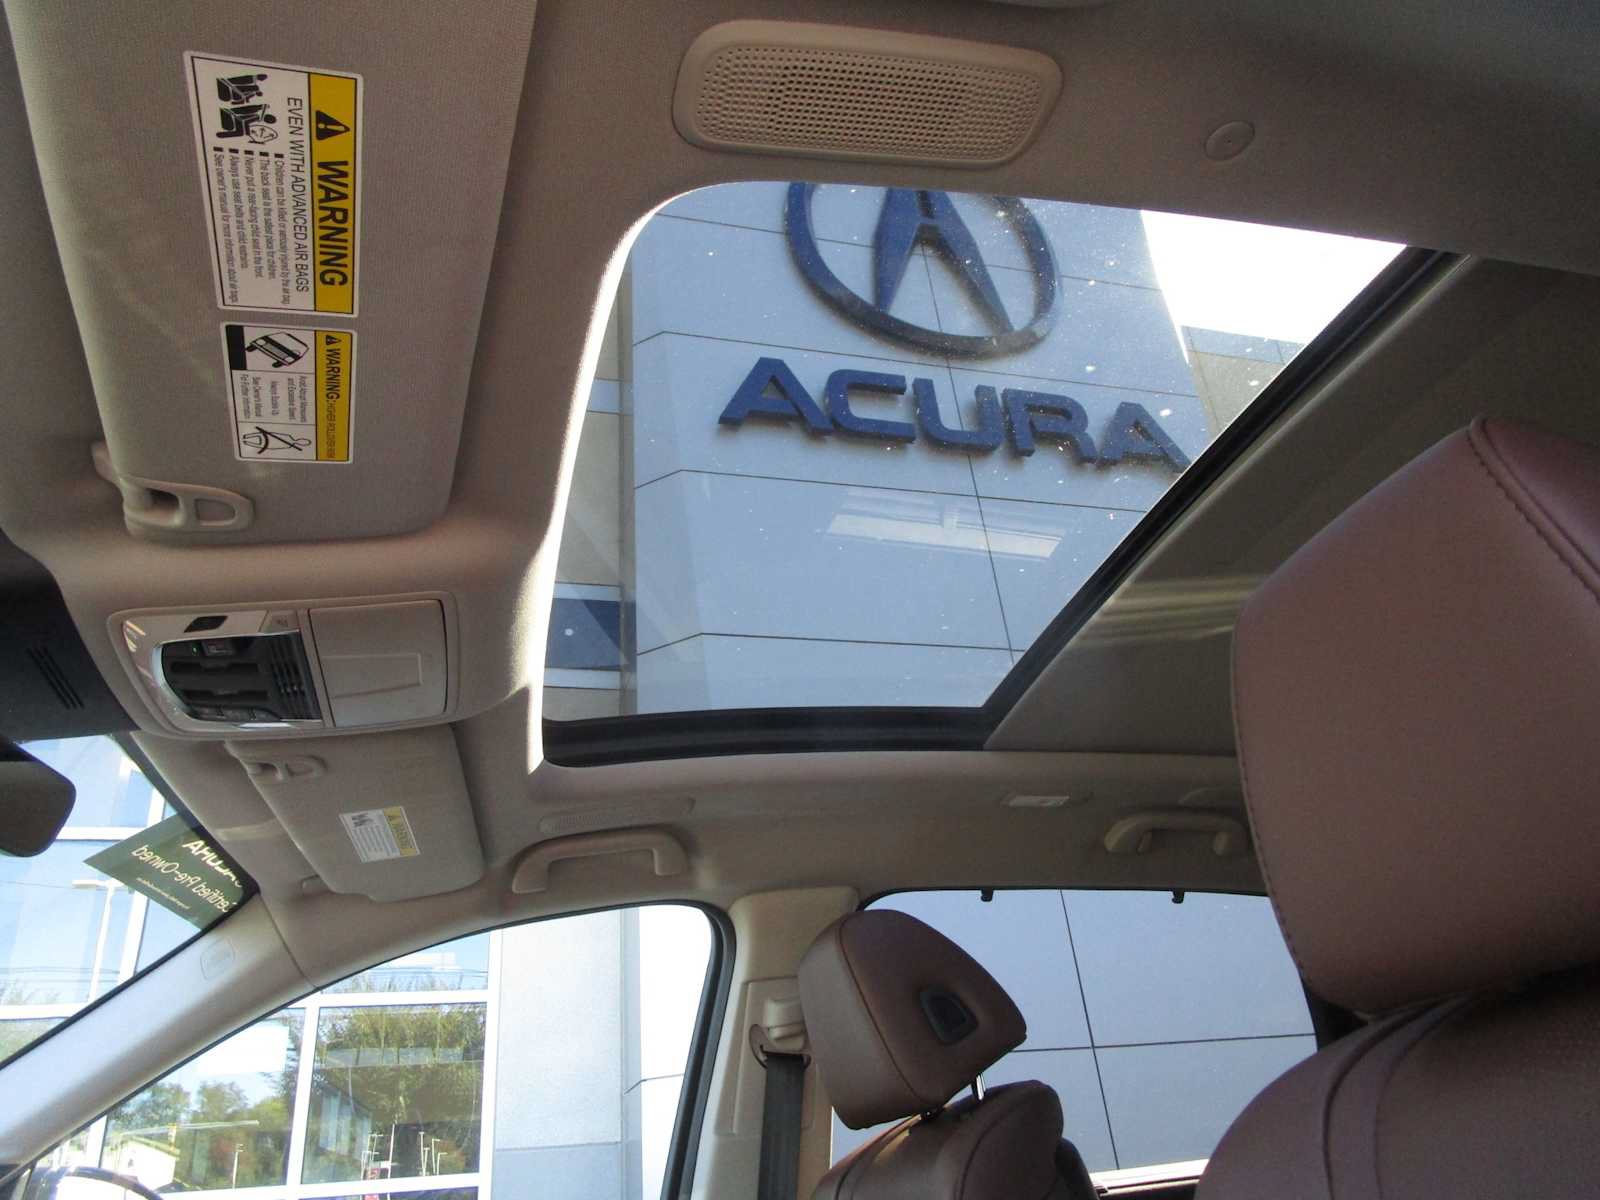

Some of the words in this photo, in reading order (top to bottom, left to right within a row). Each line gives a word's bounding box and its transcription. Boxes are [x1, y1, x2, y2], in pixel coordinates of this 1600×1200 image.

[287, 98, 304, 137] EVEN
[260, 160, 270, 170] The
[289, 140, 304, 172] WITH
[261, 172, 270, 185] back
[275, 161, 285, 185] Children
[291, 175, 307, 240] ADVANCED
[318, 161, 349, 285] WARNING
[295, 242, 308, 260] AIR
[295, 264, 309, 292] BAGS
[718, 356, 1192, 474] ACURA
